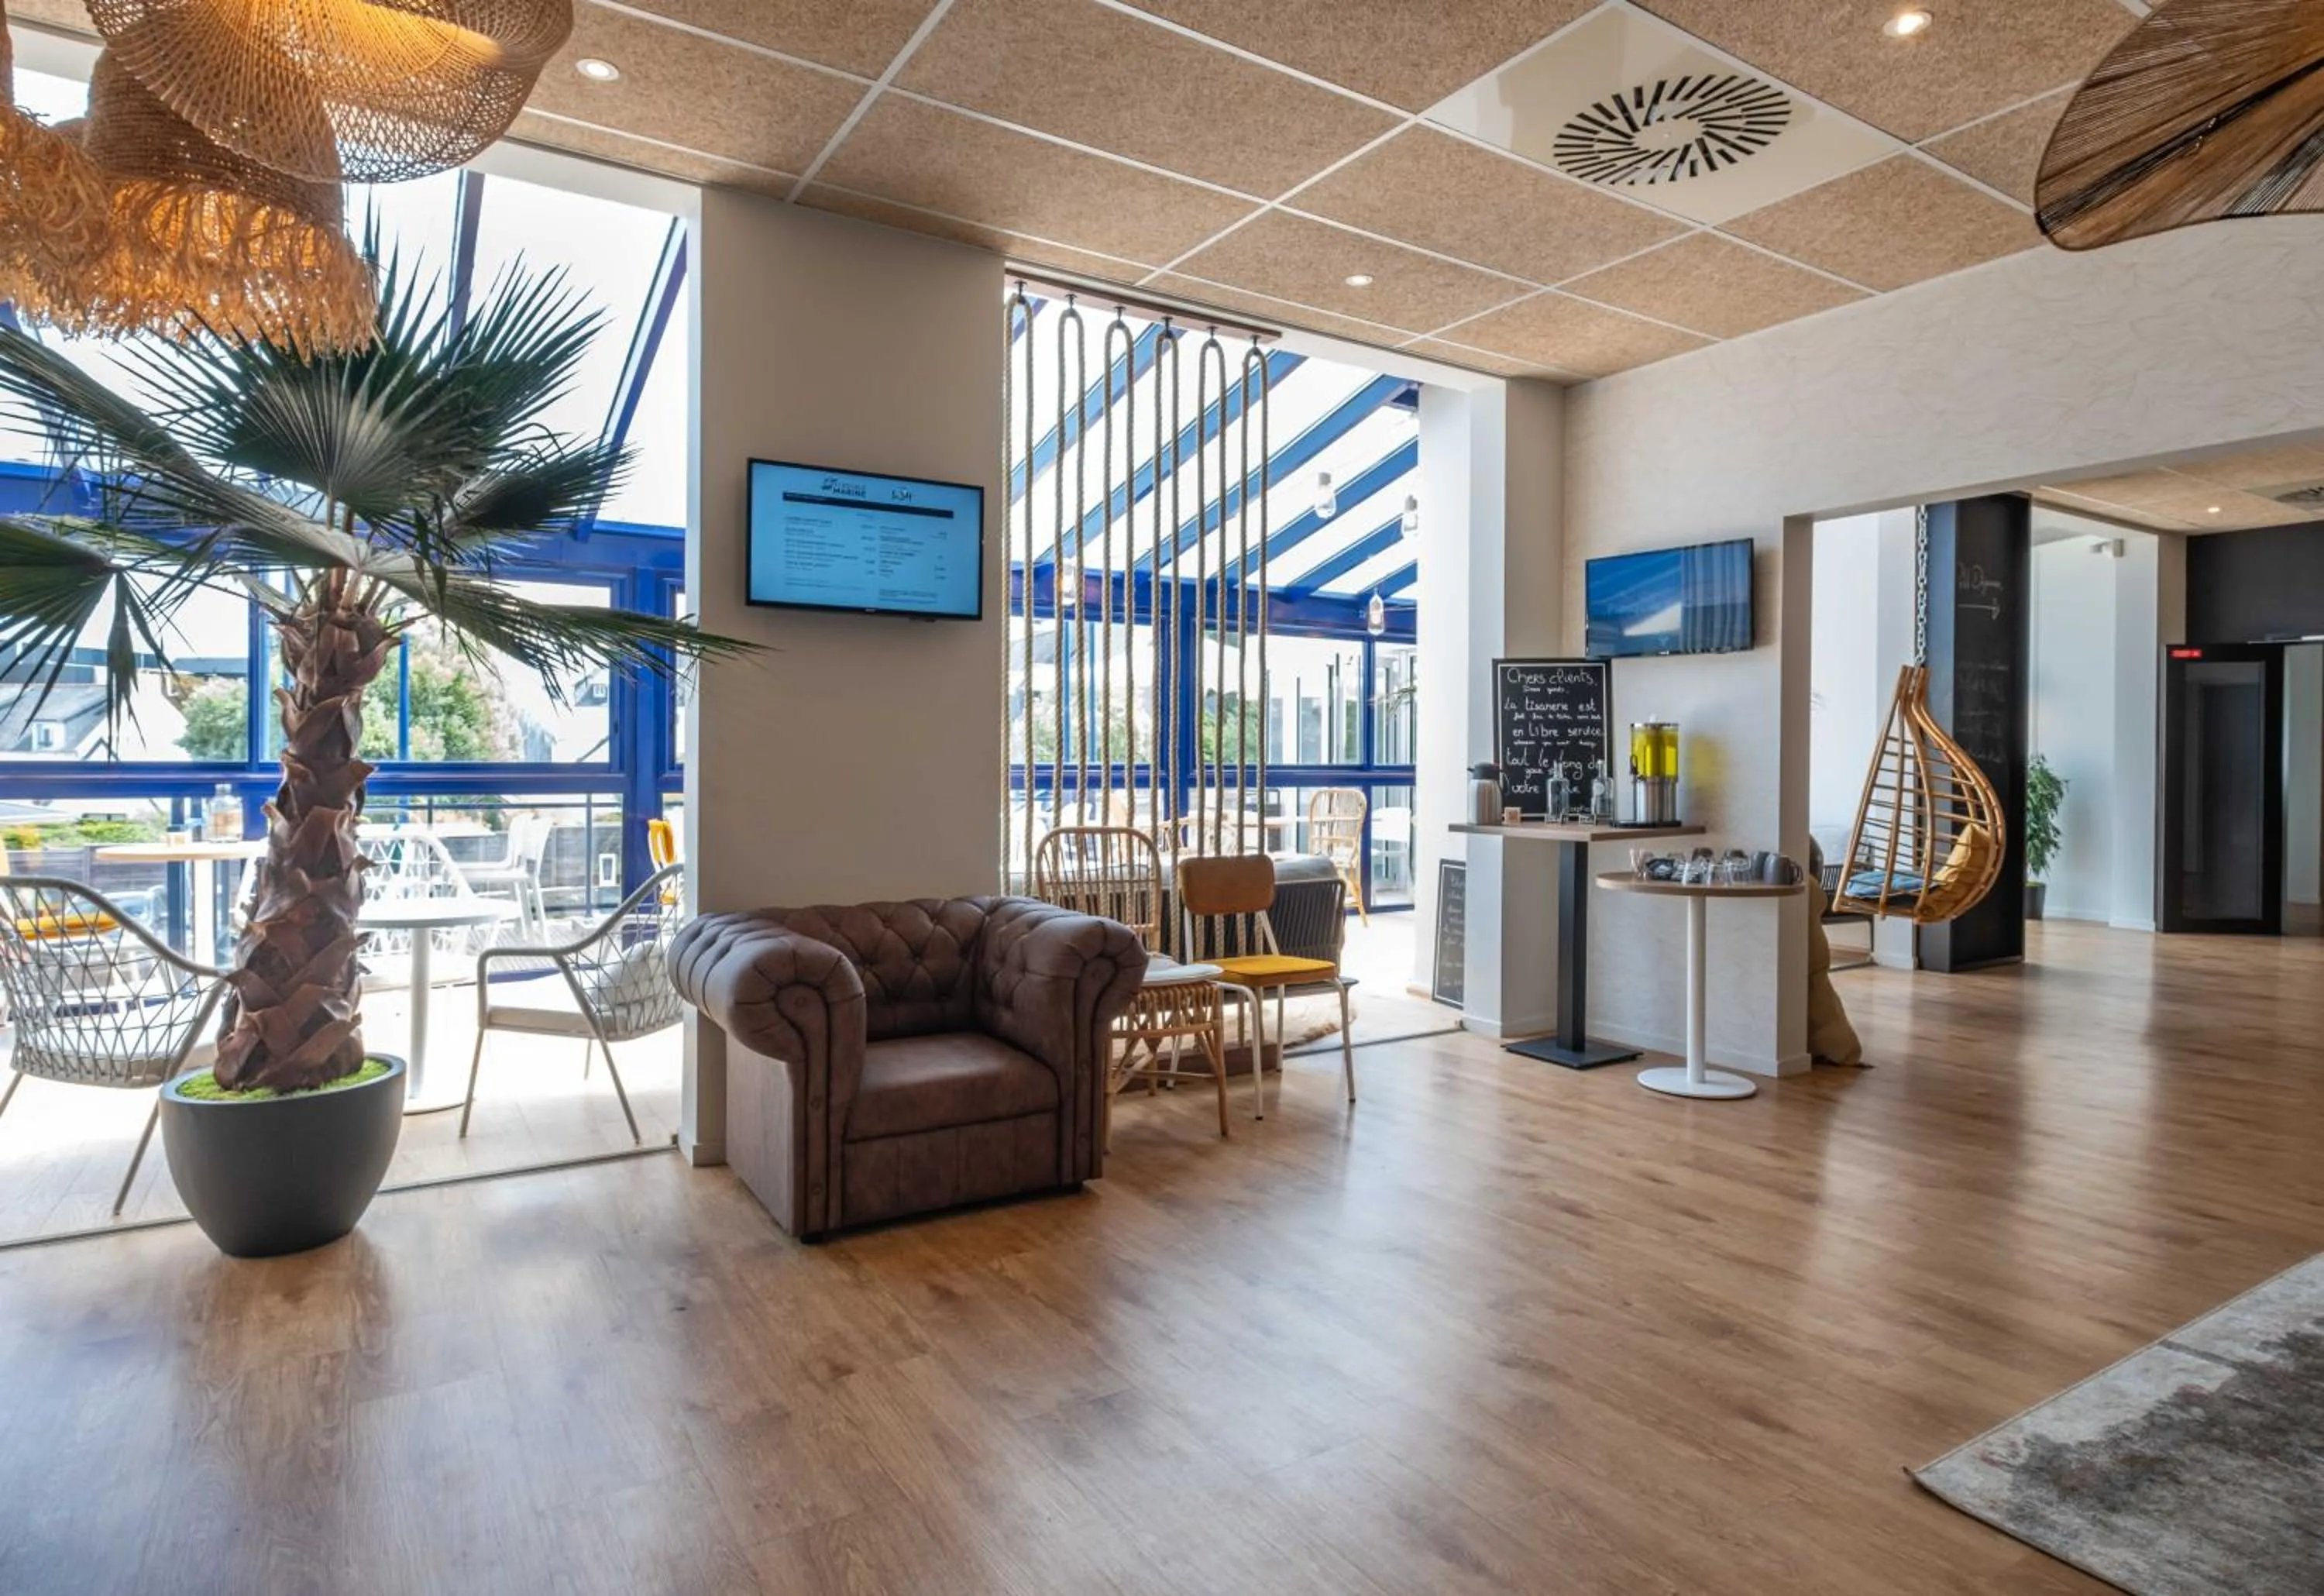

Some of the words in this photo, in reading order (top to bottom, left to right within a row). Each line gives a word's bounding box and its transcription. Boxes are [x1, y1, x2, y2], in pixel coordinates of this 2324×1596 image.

[1578, 697, 1596, 712] est
[1506, 747, 1530, 766] tout
[1538, 748, 1549, 768] le
[1511, 779, 1539, 794] votre
